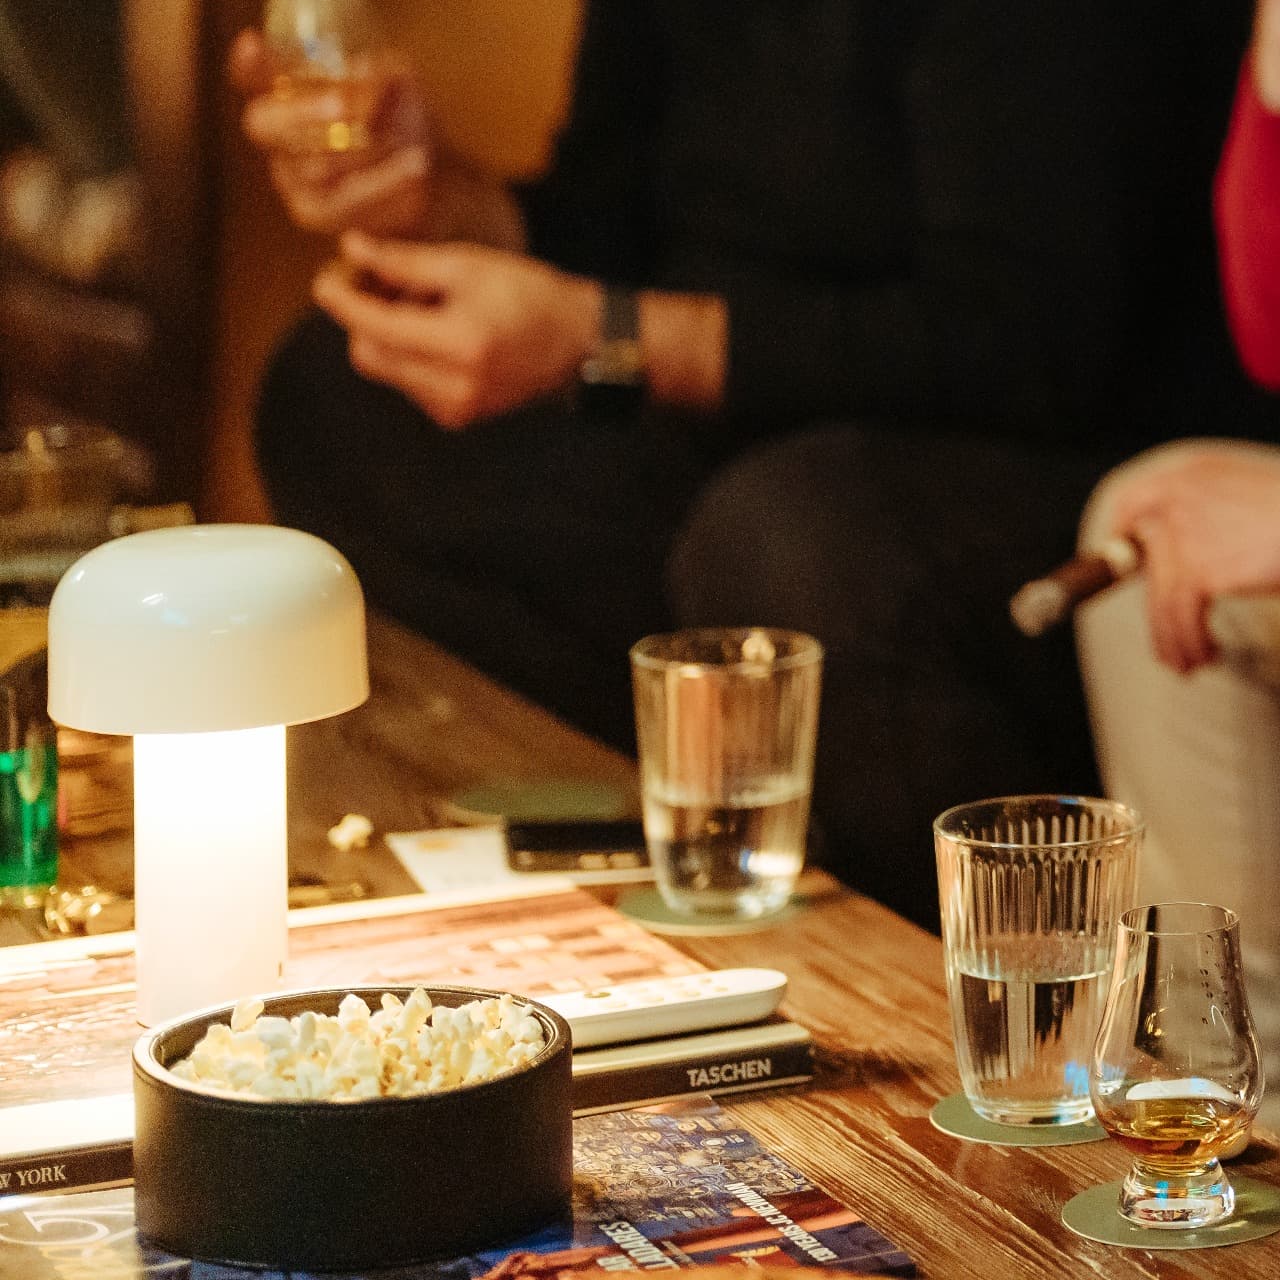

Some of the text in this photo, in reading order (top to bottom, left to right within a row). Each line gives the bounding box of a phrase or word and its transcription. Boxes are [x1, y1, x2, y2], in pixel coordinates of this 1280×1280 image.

[687, 1058, 771, 1087] TASCHEN
[16, 1165, 66, 1186] YORK
[725, 1182, 782, 1217] NEWMAN
[598, 1221, 680, 1271] LADARES
[778, 1224, 821, 1251] YEARS
